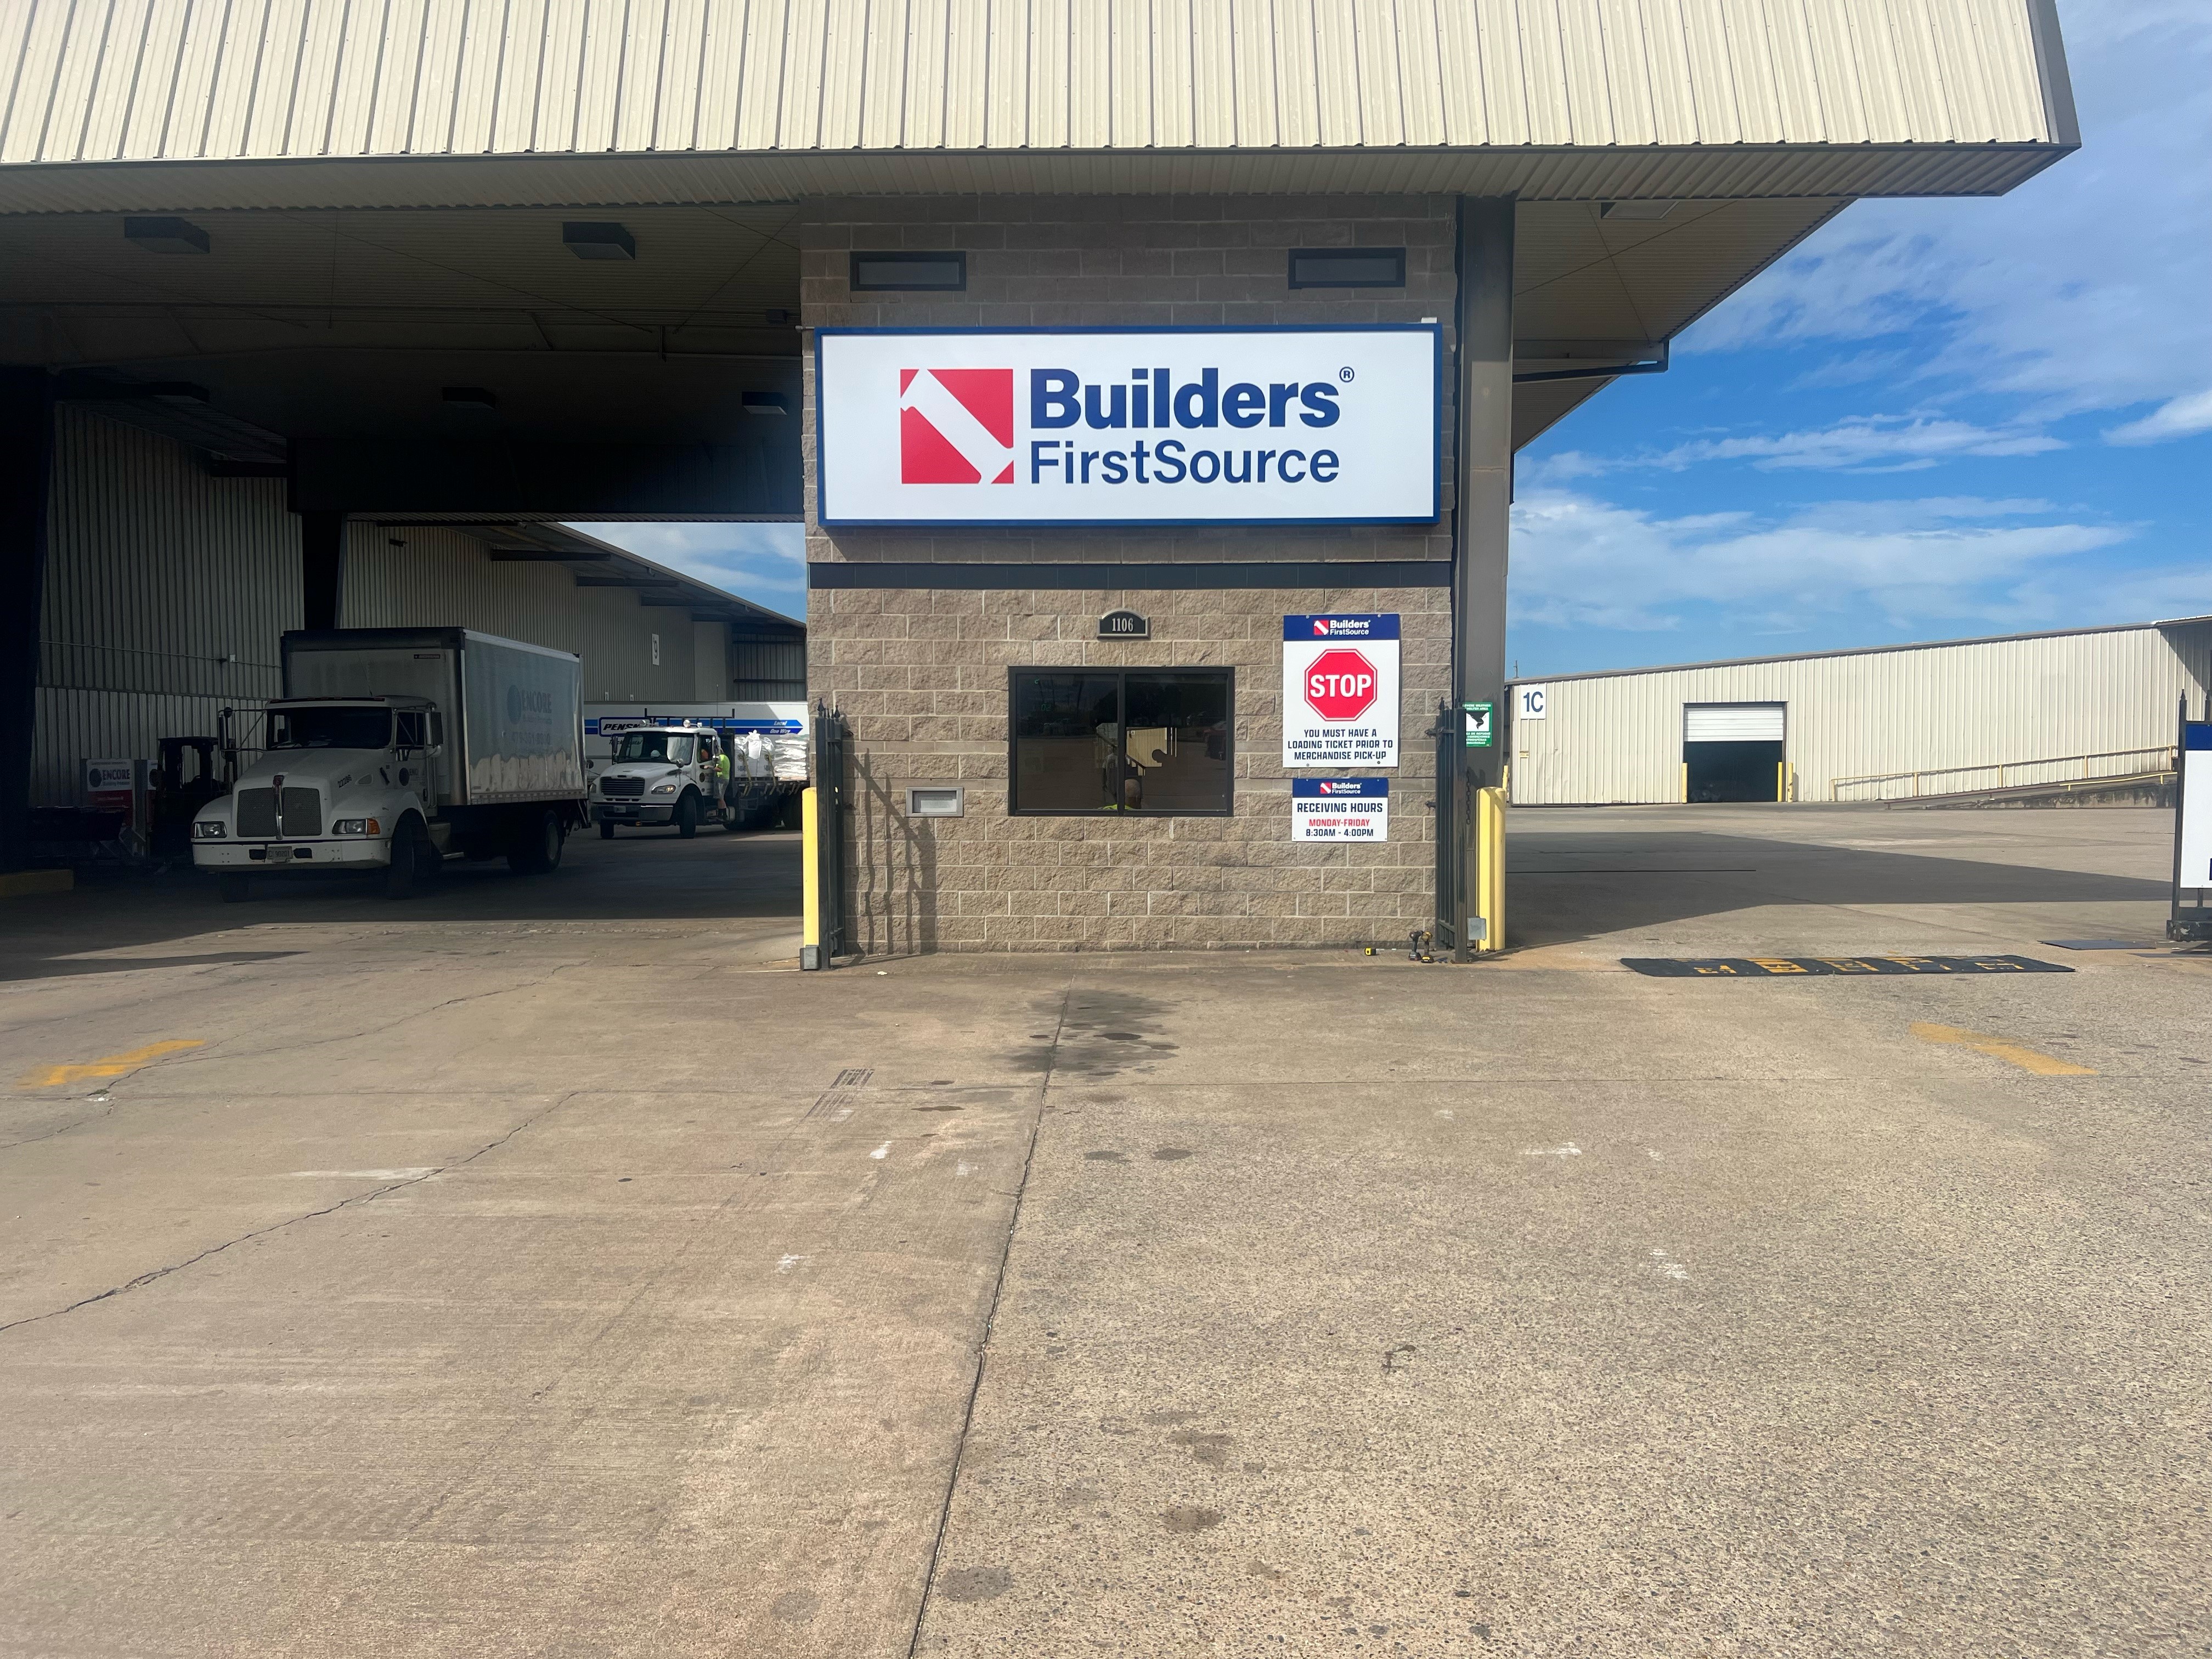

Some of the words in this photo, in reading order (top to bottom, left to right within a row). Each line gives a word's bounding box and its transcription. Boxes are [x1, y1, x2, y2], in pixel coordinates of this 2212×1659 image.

[1031, 439, 1339, 484] FirstSource
[1111, 617, 1134, 633] 1106
[1310, 674, 1372, 698] STOP
[1523, 691, 1544, 713] 1C
[1304, 729, 1319, 737] YOU
[1323, 729, 1346, 737] MUST
[1348, 729, 1369, 737] HAVE
[1372, 729, 1377, 737] A
[1288, 741, 1322, 749] LOADING
[1325, 740, 1353, 749] TICKET
[1356, 740, 1380, 748] PRIOR
[1383, 740, 1393, 748] TO
[1294, 751, 1351, 760] MERCHANDISE
[1354, 751, 1386, 759] PICK-UP
[102, 769, 131, 780] ENCORE
[1297, 803, 1347, 812] RECEIVING
[1351, 803, 1383, 812] HOURS
[1308, 819, 1370, 827] MONDAY-FRIDAY
[1306, 828, 1335, 837] 8:30AM
